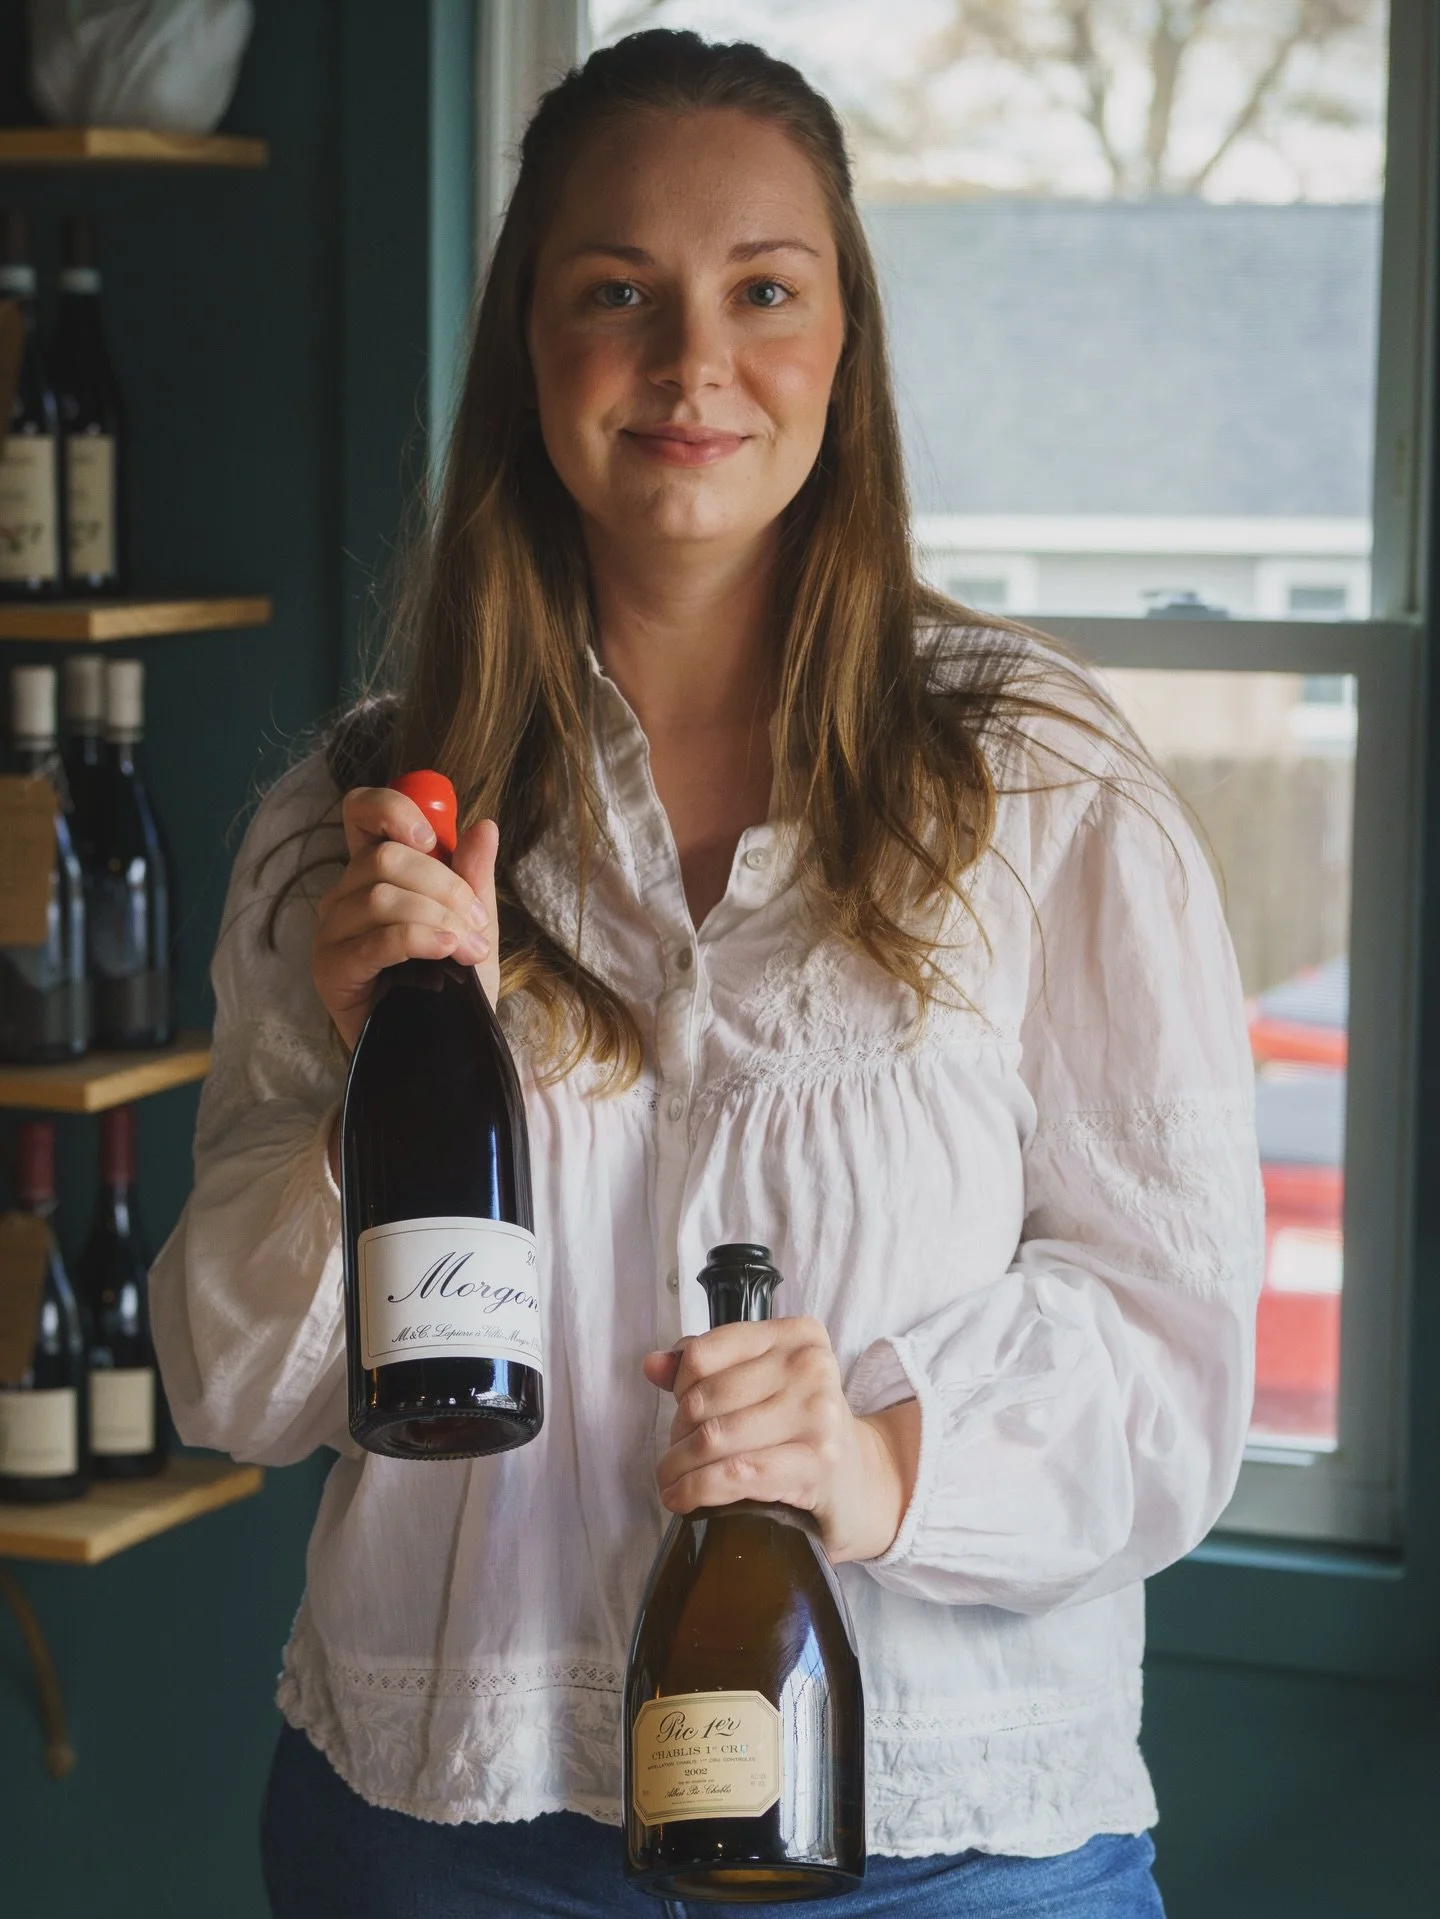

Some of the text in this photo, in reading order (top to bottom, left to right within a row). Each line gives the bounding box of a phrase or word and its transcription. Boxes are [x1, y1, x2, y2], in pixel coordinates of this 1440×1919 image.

[387, 1251, 539, 1314] Morgon
[432, 1323, 474, 1341] Lapierre
[656, 1711, 742, 1744] Pic 1er
[652, 1746, 701, 1761] CHABLIS
[684, 1767, 708, 1777] 2002
